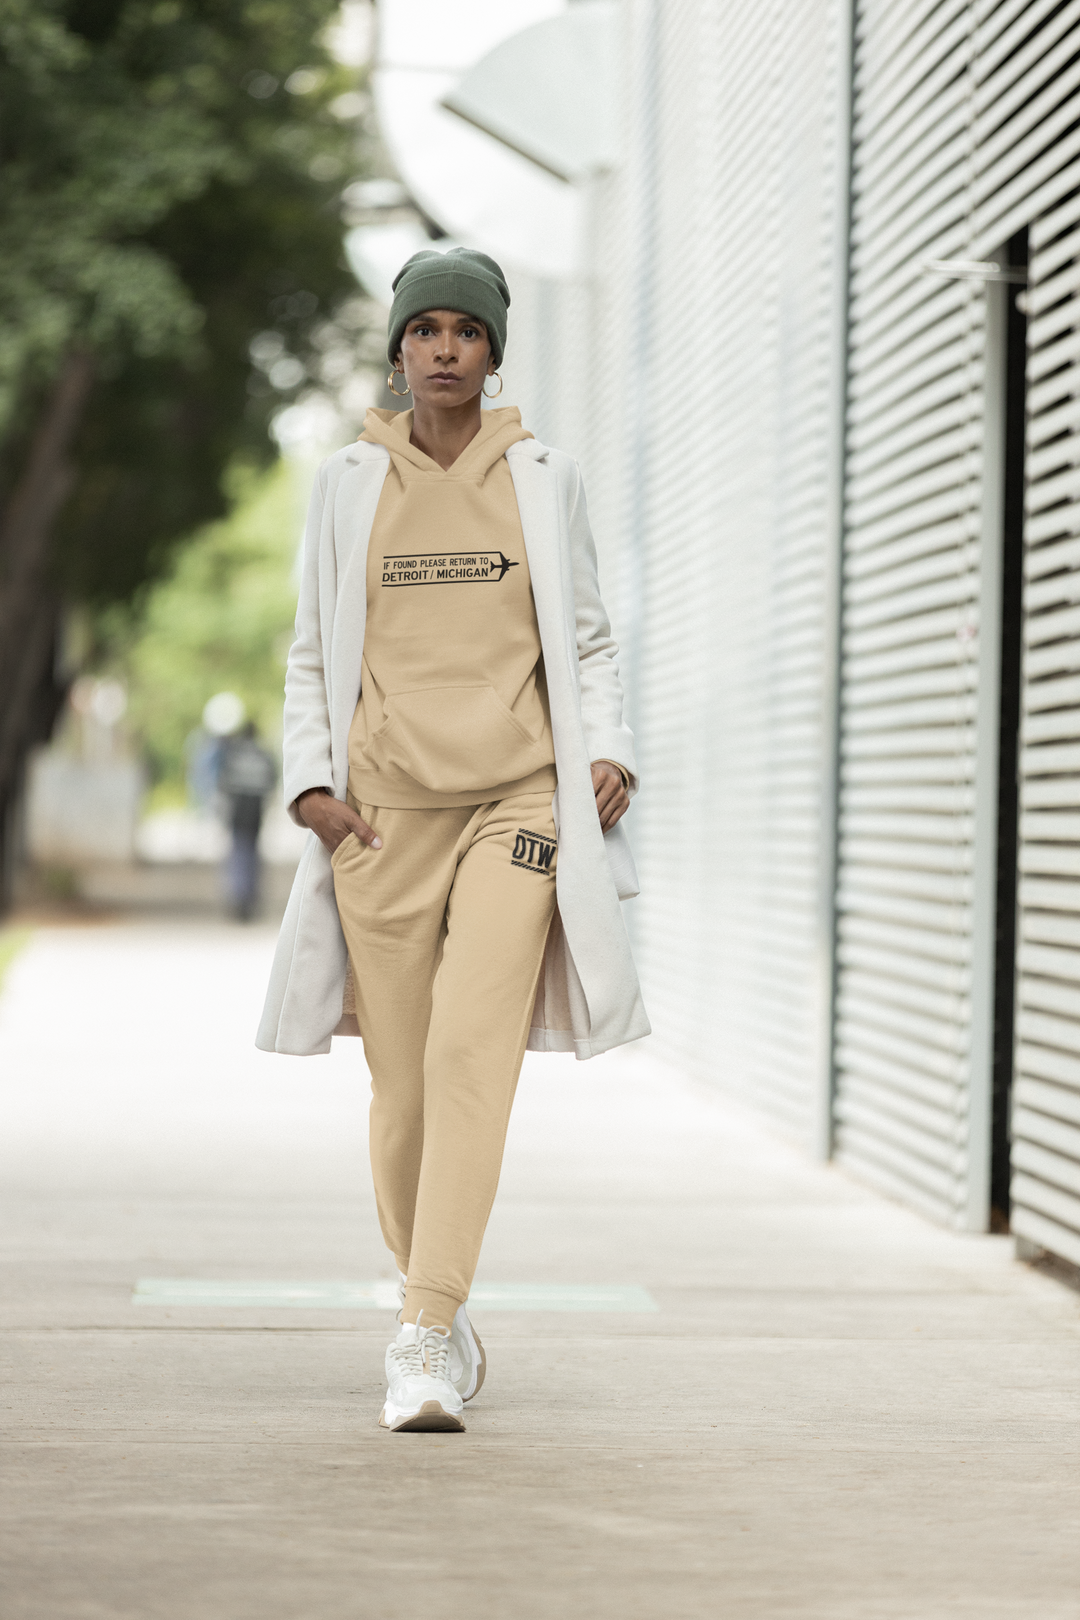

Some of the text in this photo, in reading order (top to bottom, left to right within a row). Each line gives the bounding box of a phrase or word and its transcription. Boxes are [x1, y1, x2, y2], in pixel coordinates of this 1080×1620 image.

[383, 557, 489, 570] IF FOUND PLEASE RETURN TO
[382, 570, 429, 582] DETROIT
[436, 567, 489, 578] MICHIGAN
[512, 834, 556, 869] DTW
